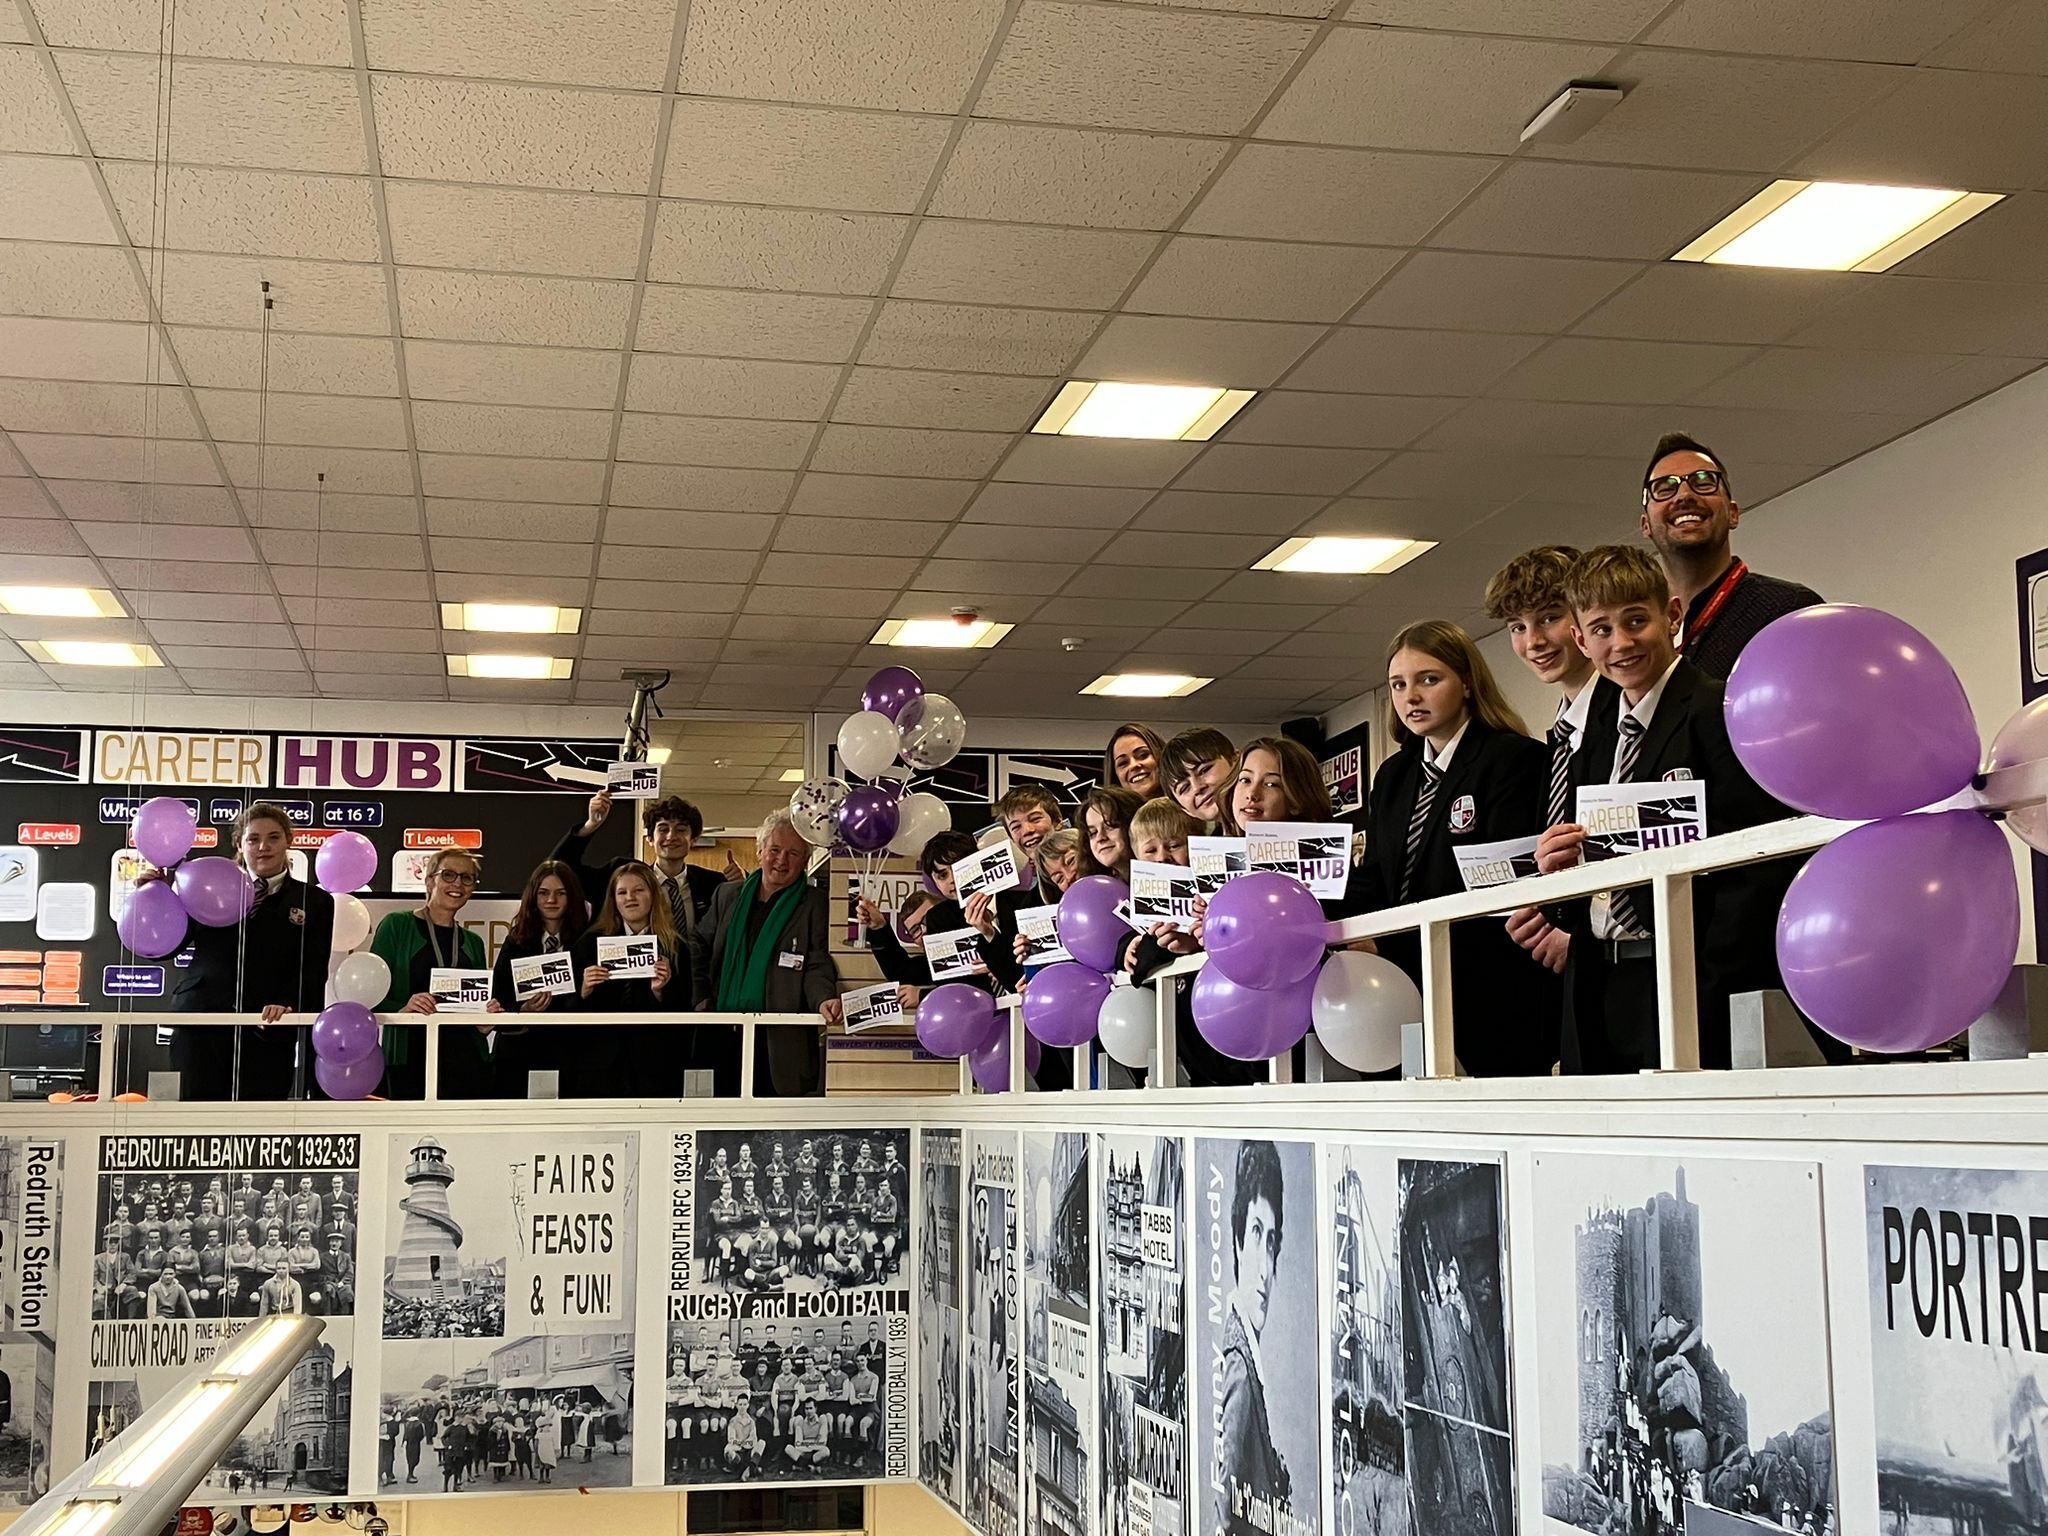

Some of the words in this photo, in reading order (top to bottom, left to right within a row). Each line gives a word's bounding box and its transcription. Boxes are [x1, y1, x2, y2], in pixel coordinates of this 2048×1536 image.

[100, 734, 263, 785] CAREER
[284, 739, 441, 789] HUB
[1333, 750, 1358, 780] HUB
[633, 779, 658, 790] HUB
[213, 808, 238, 821] my
[326, 808, 343, 820] at
[347, 808, 363, 821] 16
[1580, 805, 1637, 833] CAREER
[20, 828, 31, 840] A
[35, 828, 74, 841] Levels
[406, 833, 414, 845] T
[417, 832, 455, 846] Levels
[1191, 855, 1226, 874] CAREER
[1249, 841, 1297, 861] CAREER
[984, 862, 1014, 885] HUB
[1300, 859, 1345, 881] HUB
[1463, 861, 1514, 885] CAREER
[1132, 878, 1169, 897] CAREER
[628, 954, 656, 969] HUB
[544, 970, 572, 986] HUB
[461, 990, 489, 1002] HUB
[872, 1001, 900, 1018] HUB
[105, 1138, 184, 1168] REDRUTH
[187, 1137, 256, 1167] ALBANY
[259, 1136, 292, 1166] RFC
[297, 1136, 357, 1166] 1932-33
[674, 1132, 693, 1184] 1934-35
[534, 1153, 614, 1194] FAIRS
[24, 1146, 54, 1237] Redruth
[673, 1189, 692, 1217] RFC
[532, 1213, 613, 1255] FEASTS
[1143, 1211, 1172, 1234] TABBS
[671, 1222, 691, 1291] REDRUTH
[1005, 1188, 1018, 1321] COPPER
[1143, 1238, 1173, 1262] HOTEL
[1207, 1161, 1224, 1325] Moody
[1335, 1176, 1352, 1360] MINE
[20, 1246, 50, 1327] Station
[530, 1274, 545, 1316] &
[563, 1274, 611, 1315] FUN!
[671, 1293, 745, 1322] RUGBY
[752, 1292, 788, 1320] and
[795, 1289, 907, 1319] FOOTBALL
[195, 1323, 213, 1340] FINE
[889, 1317, 907, 1340] 1935
[91, 1323, 148, 1368] CLINTON
[151, 1322, 188, 1367] ROAD
[1006, 1332, 1018, 1400] AND
[887, 1360, 907, 1419] FOOTBALL
[1006, 1406, 1018, 1458] TIN
[1210, 1341, 1229, 1494] Fanny
[887, 1420, 907, 1477] REDRUTH
[1136, 1413, 1182, 1501] MURDOCH
